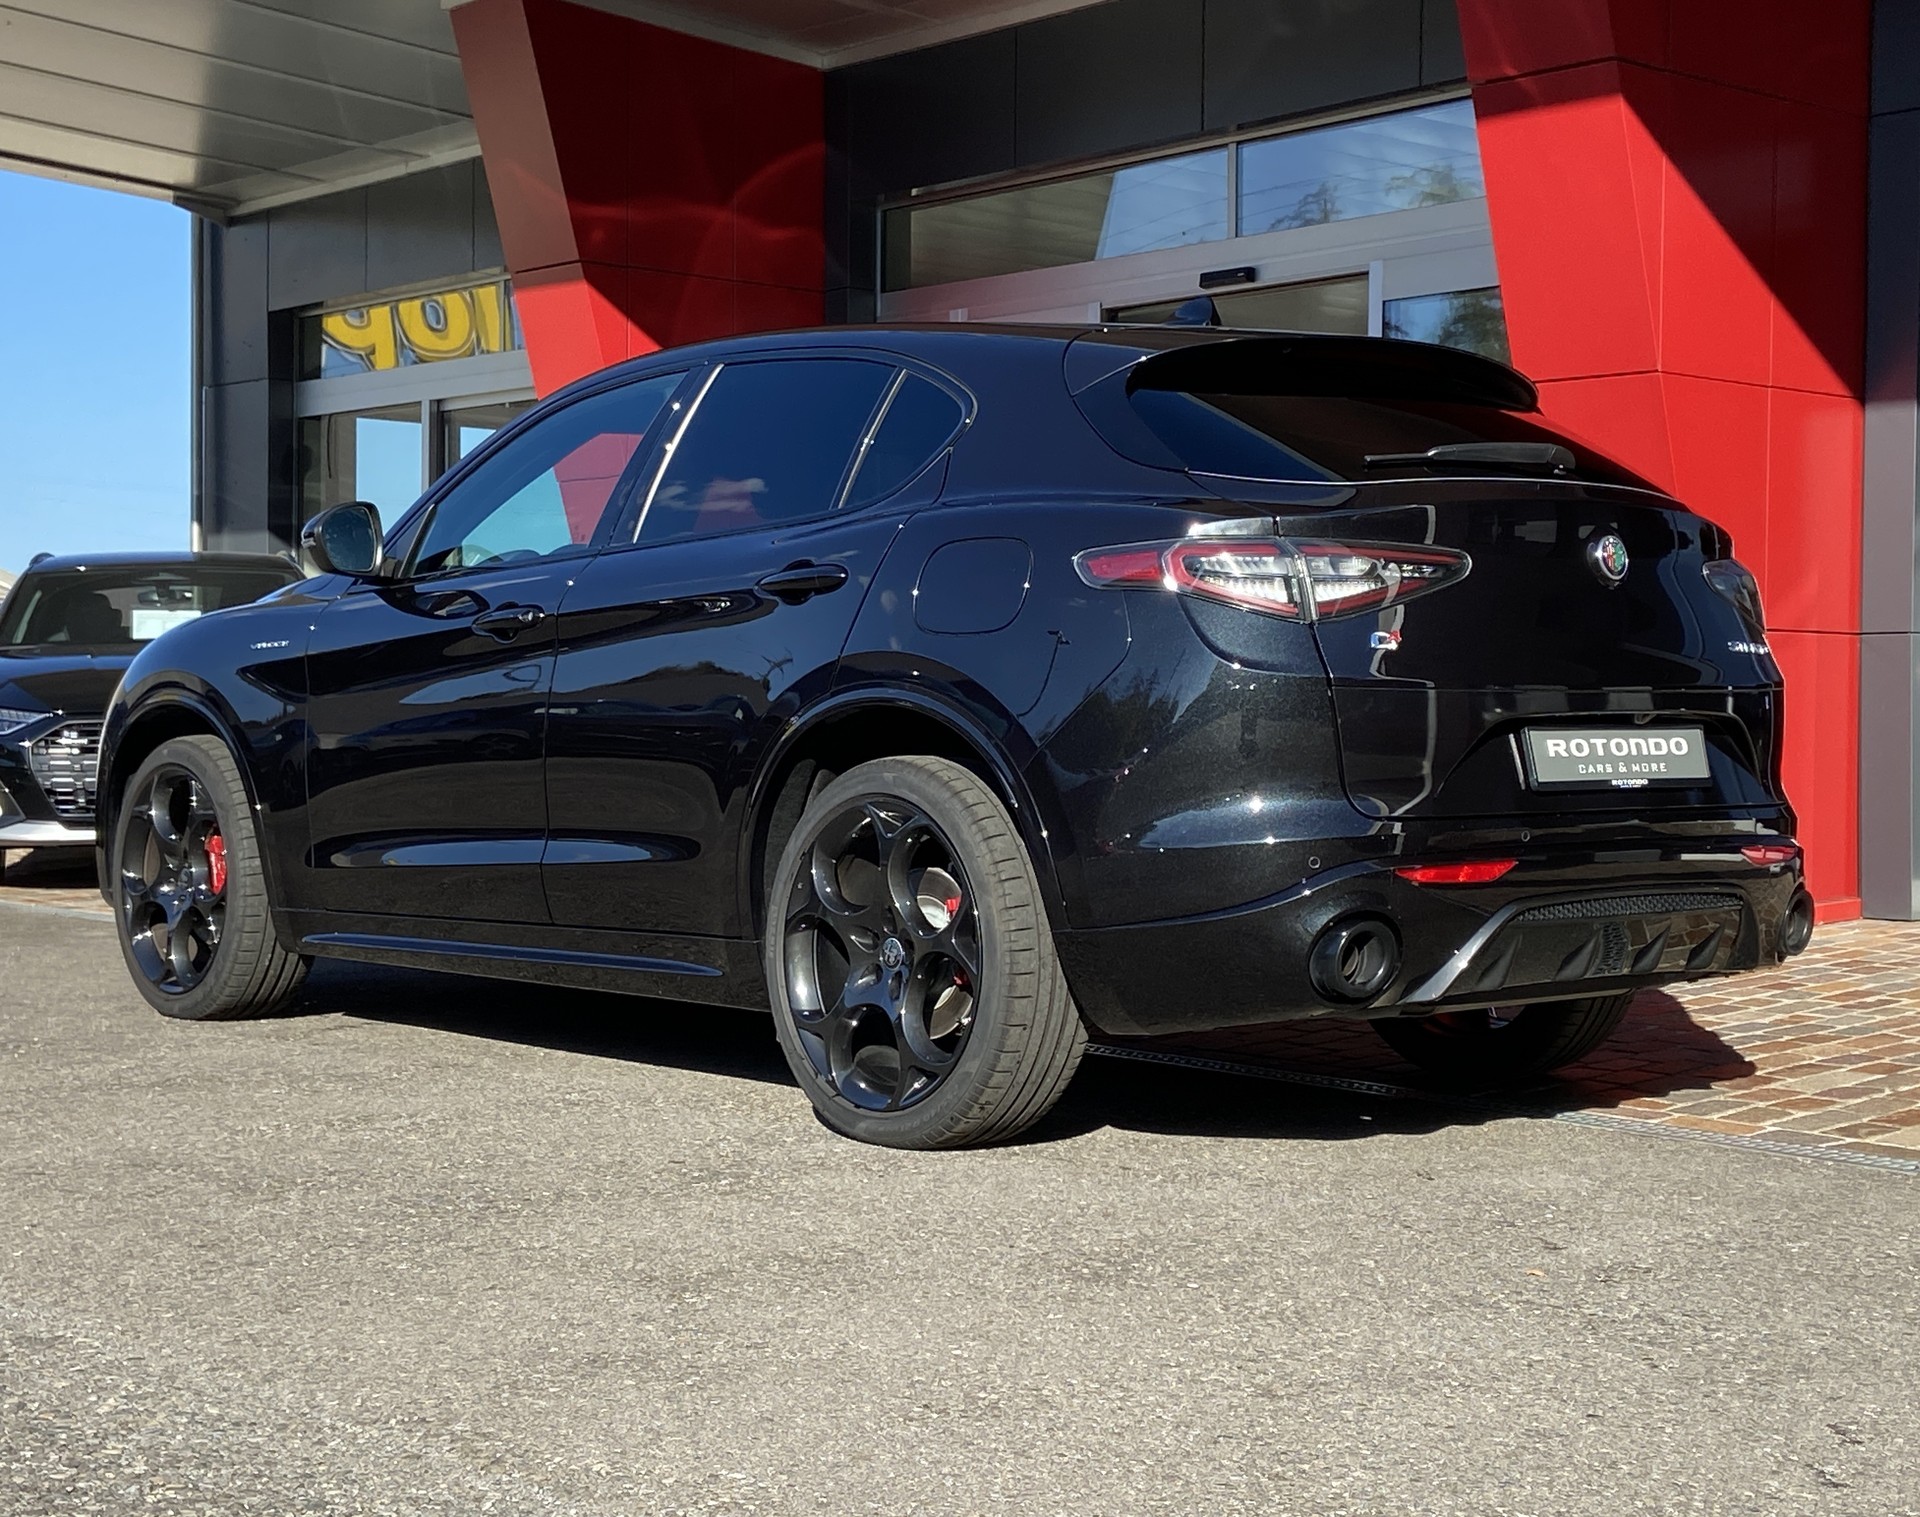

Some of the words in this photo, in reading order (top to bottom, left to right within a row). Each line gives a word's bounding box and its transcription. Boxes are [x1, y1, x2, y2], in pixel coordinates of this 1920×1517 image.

[1547, 737, 1689, 757] ROTONDO
[1578, 764, 1613, 774] CARS
[1618, 762, 1628, 773] &
[1632, 762, 1668, 773] MORE
